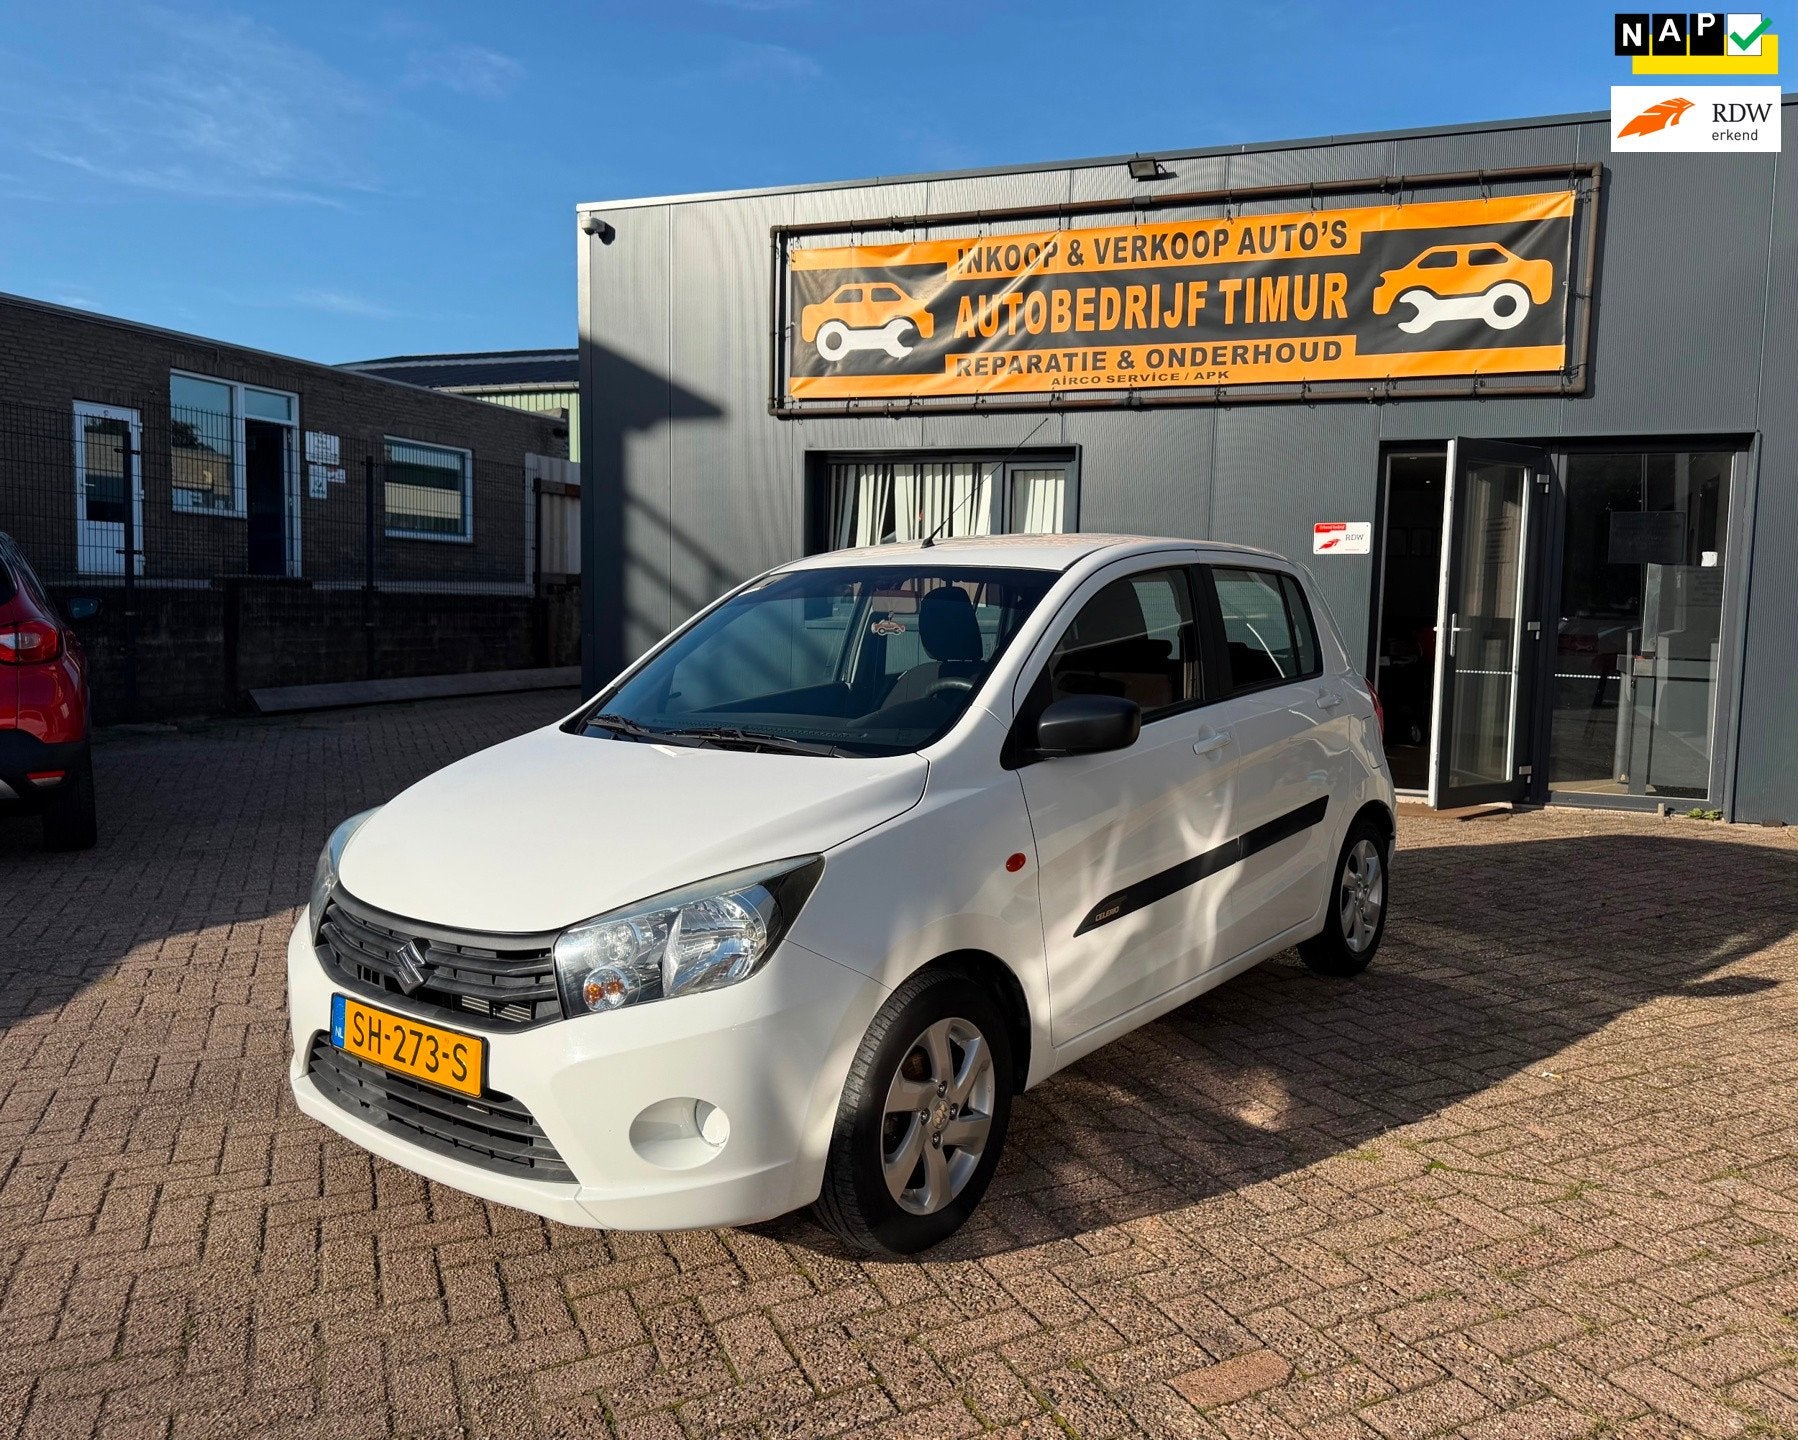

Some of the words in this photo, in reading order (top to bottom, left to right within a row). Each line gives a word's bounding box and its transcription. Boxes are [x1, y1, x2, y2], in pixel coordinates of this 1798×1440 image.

[957, 241, 1059, 274] INKOOP
[1067, 239, 1084, 267] &
[1093, 228, 1229, 265] VERKOOP
[1237, 220, 1347, 255] AUTO'S
[953, 280, 1208, 339] AUTOBEDRIJF
[1218, 272, 1348, 325] TIMUR
[956, 351, 1107, 377] REPARATIE
[1117, 350, 1135, 370] &
[1146, 341, 1342, 370] ONDERHOUD
[1193, 371, 1230, 380] APK
[1345, 533, 1364, 541] RDW
[334, 1025, 344, 1039] NL
[353, 1010, 468, 1082] SH-273-S
